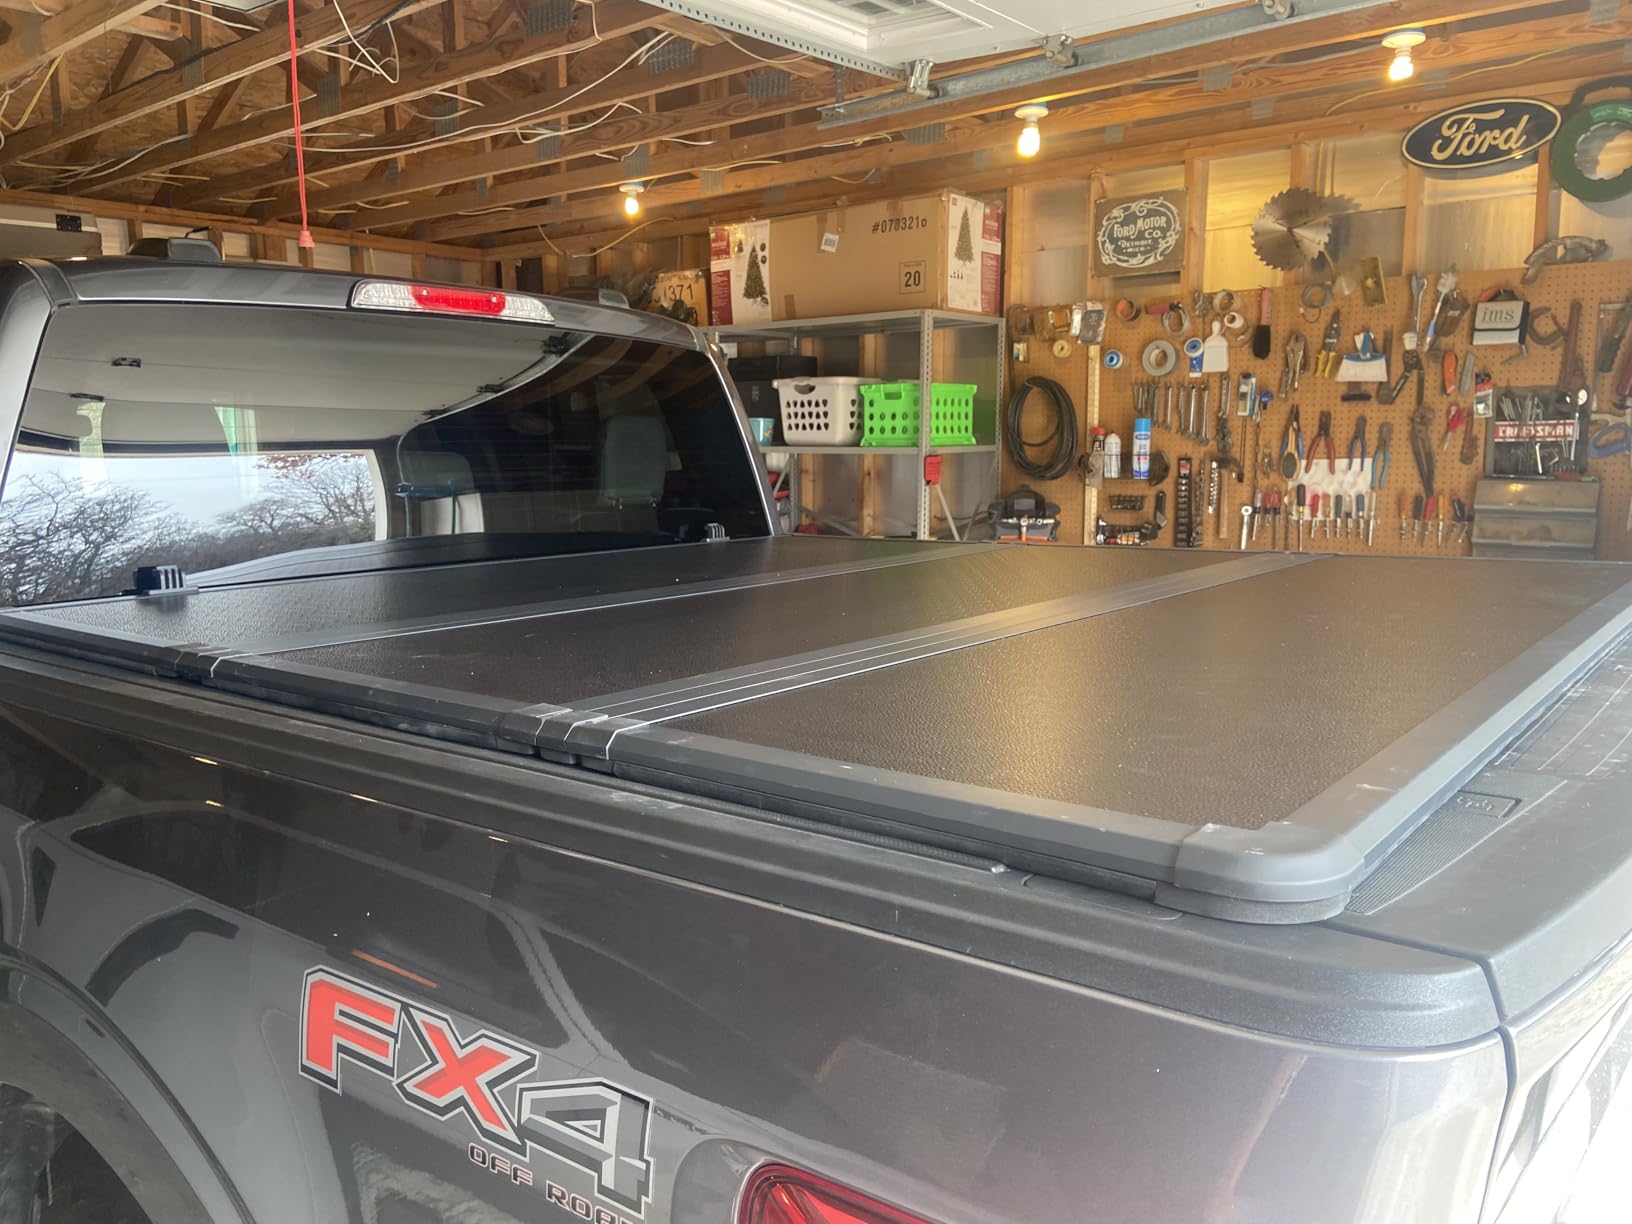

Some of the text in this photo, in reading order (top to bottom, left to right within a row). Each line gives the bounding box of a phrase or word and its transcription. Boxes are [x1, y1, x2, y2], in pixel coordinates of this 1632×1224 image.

[1431, 109, 1530, 160] Ford
[1131, 215, 1167, 238] MOTOR
[904, 270, 921, 288] 20
[1482, 307, 1515, 321] ims
[299, 964, 654, 1220] FX4
[468, 1142, 533, 1186] OFF
